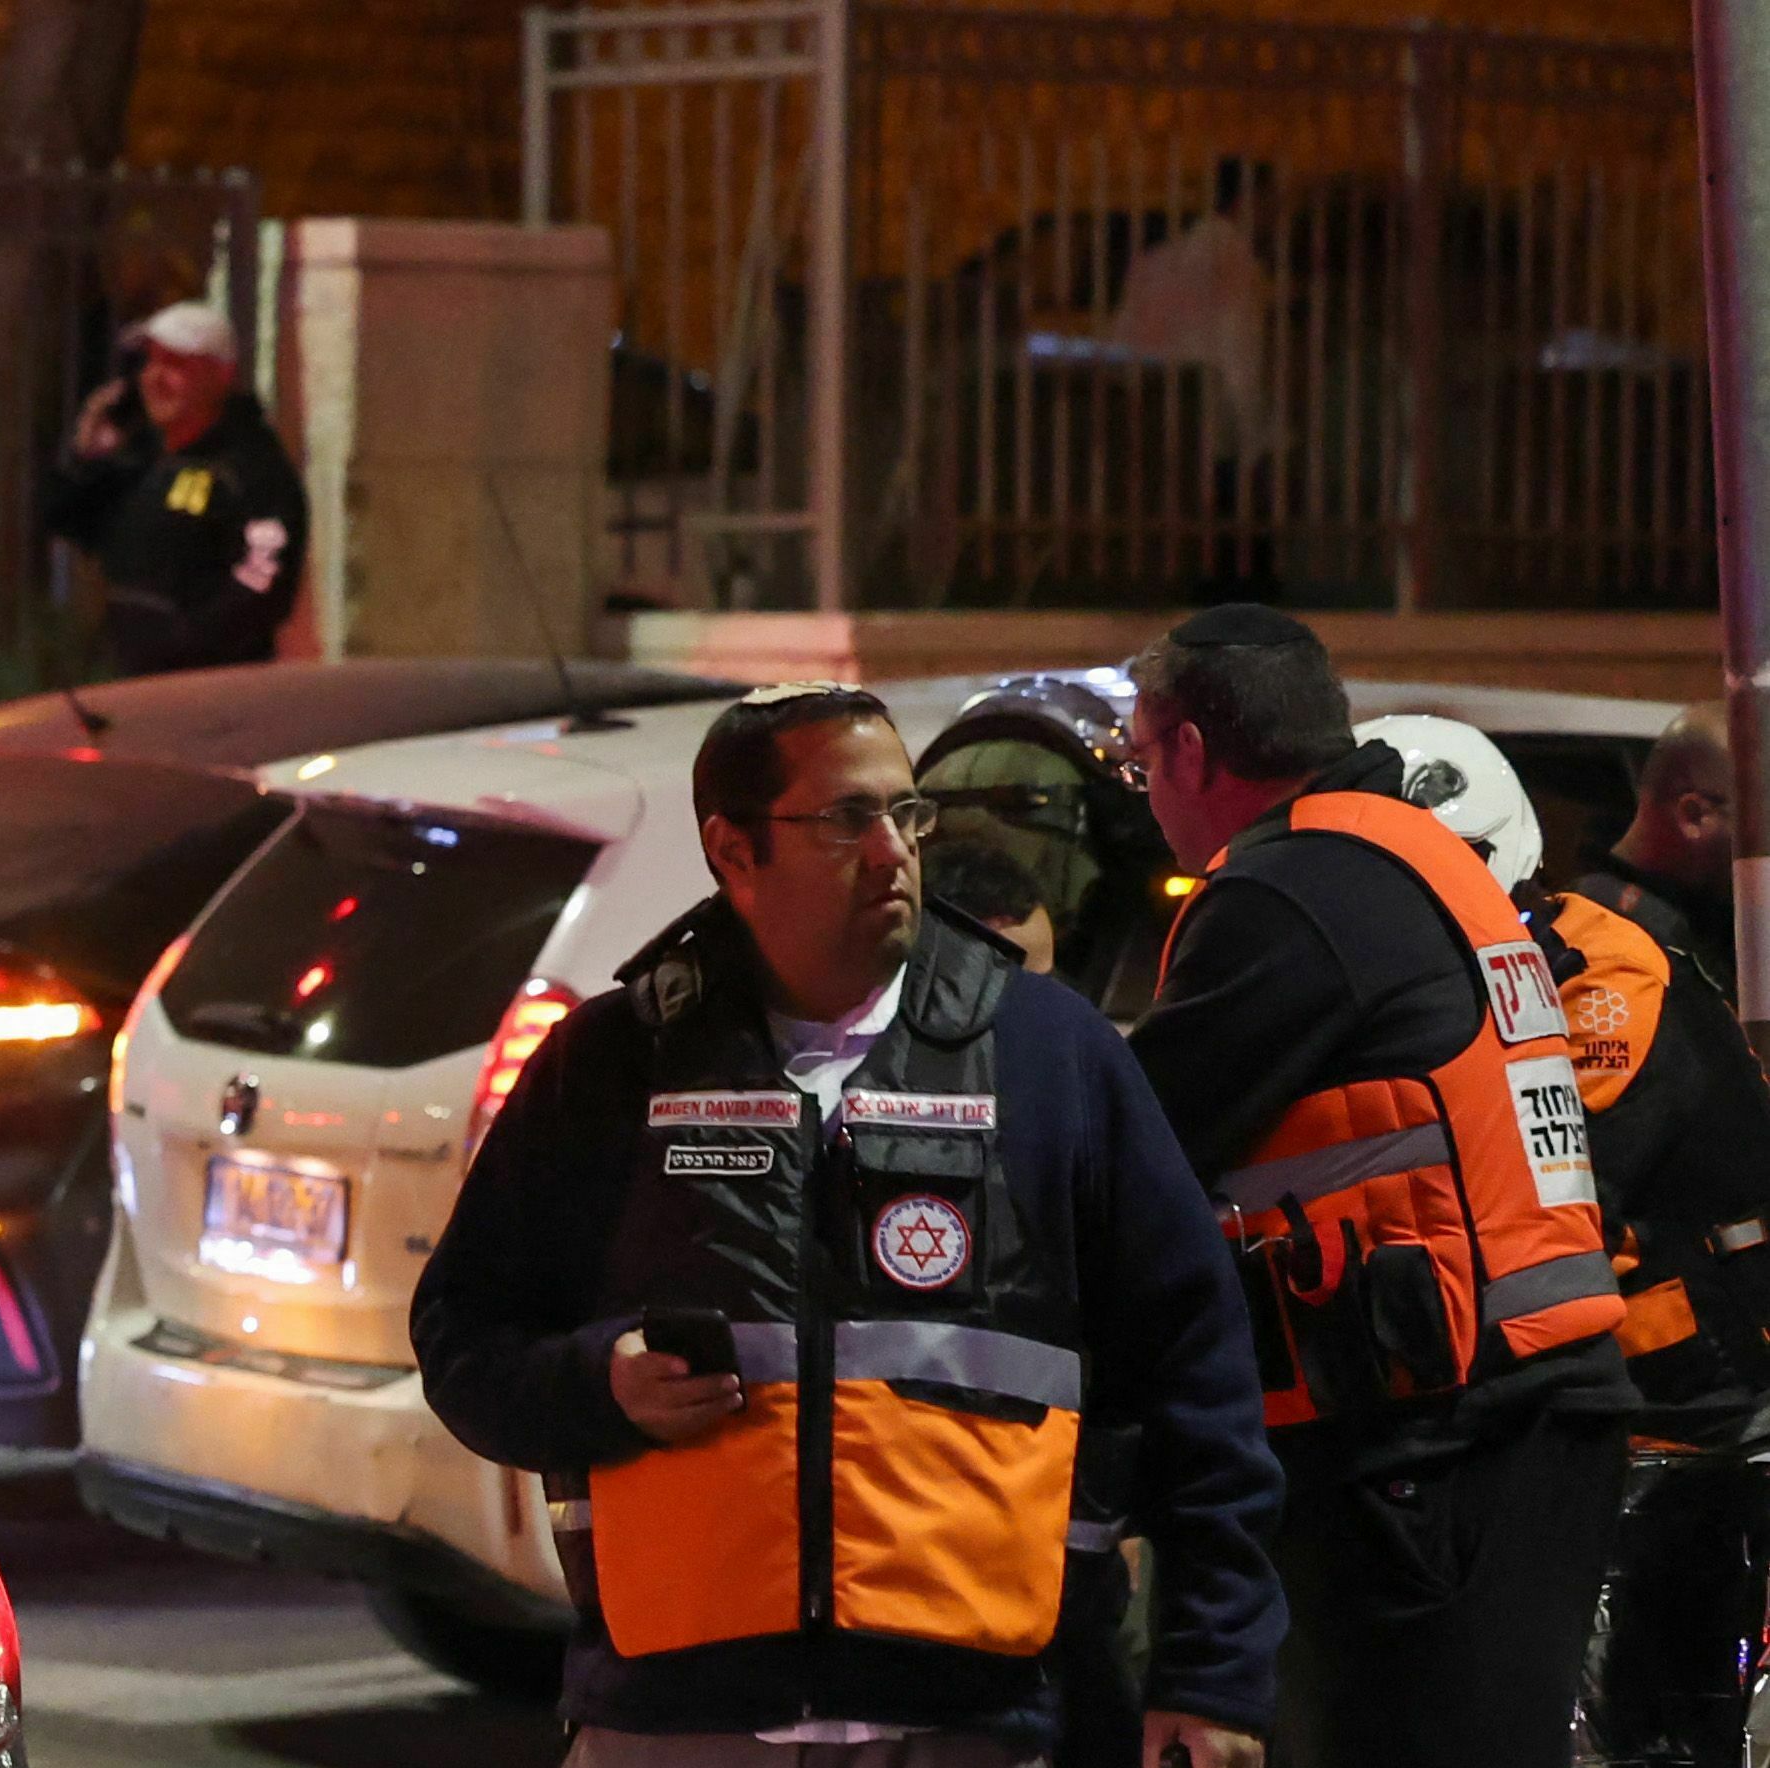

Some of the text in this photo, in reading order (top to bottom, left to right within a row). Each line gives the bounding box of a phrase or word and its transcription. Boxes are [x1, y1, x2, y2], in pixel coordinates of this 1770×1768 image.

[653, 1100, 798, 1117] MAGEN DAVID ADOM
